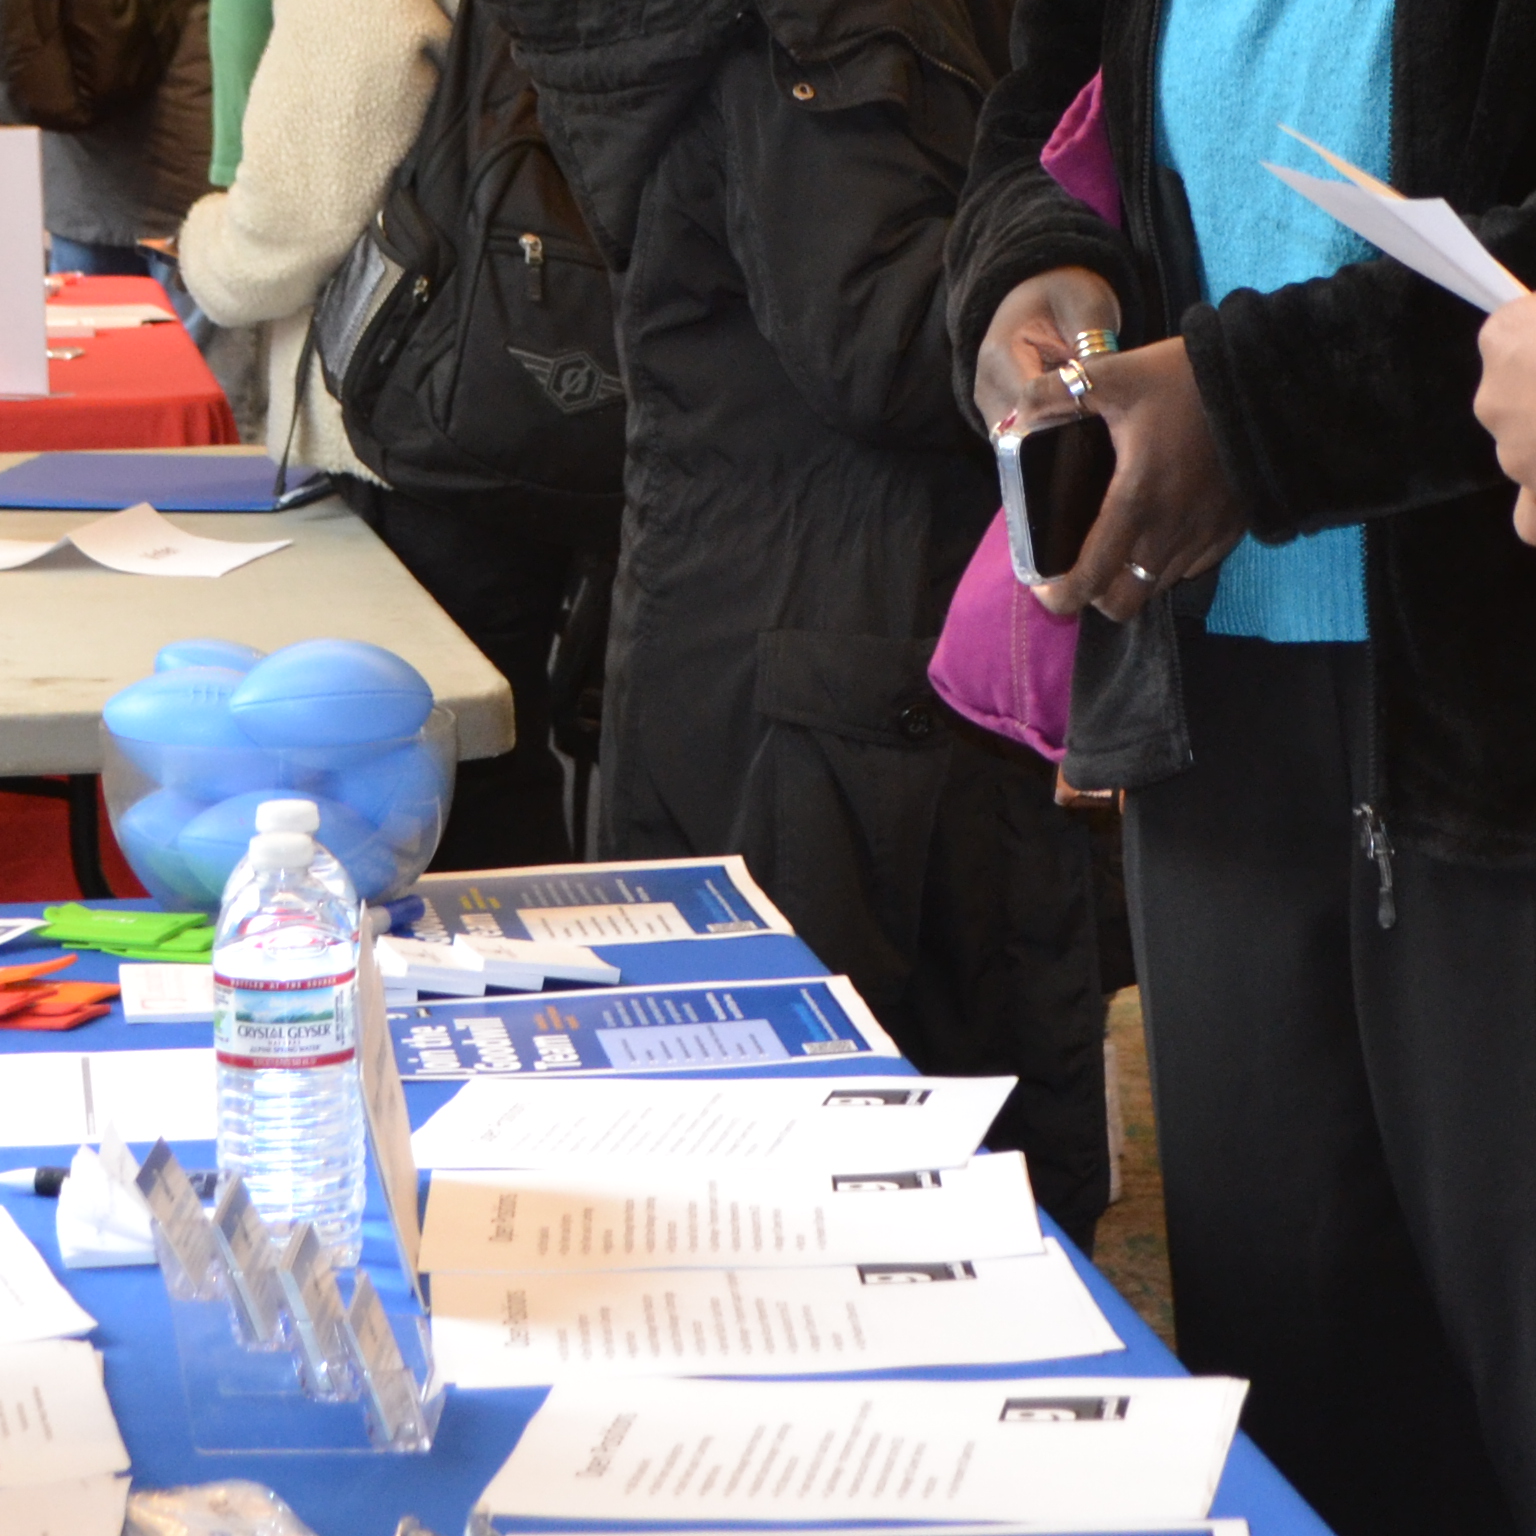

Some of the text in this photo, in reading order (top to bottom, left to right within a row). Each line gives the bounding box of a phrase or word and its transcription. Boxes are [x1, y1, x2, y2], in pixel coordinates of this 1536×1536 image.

[237, 1023, 331, 1039] CRYSTAL GEYSER
[452, 1016, 523, 1072] Goodwill
[532, 1033, 583, 1071] Team
